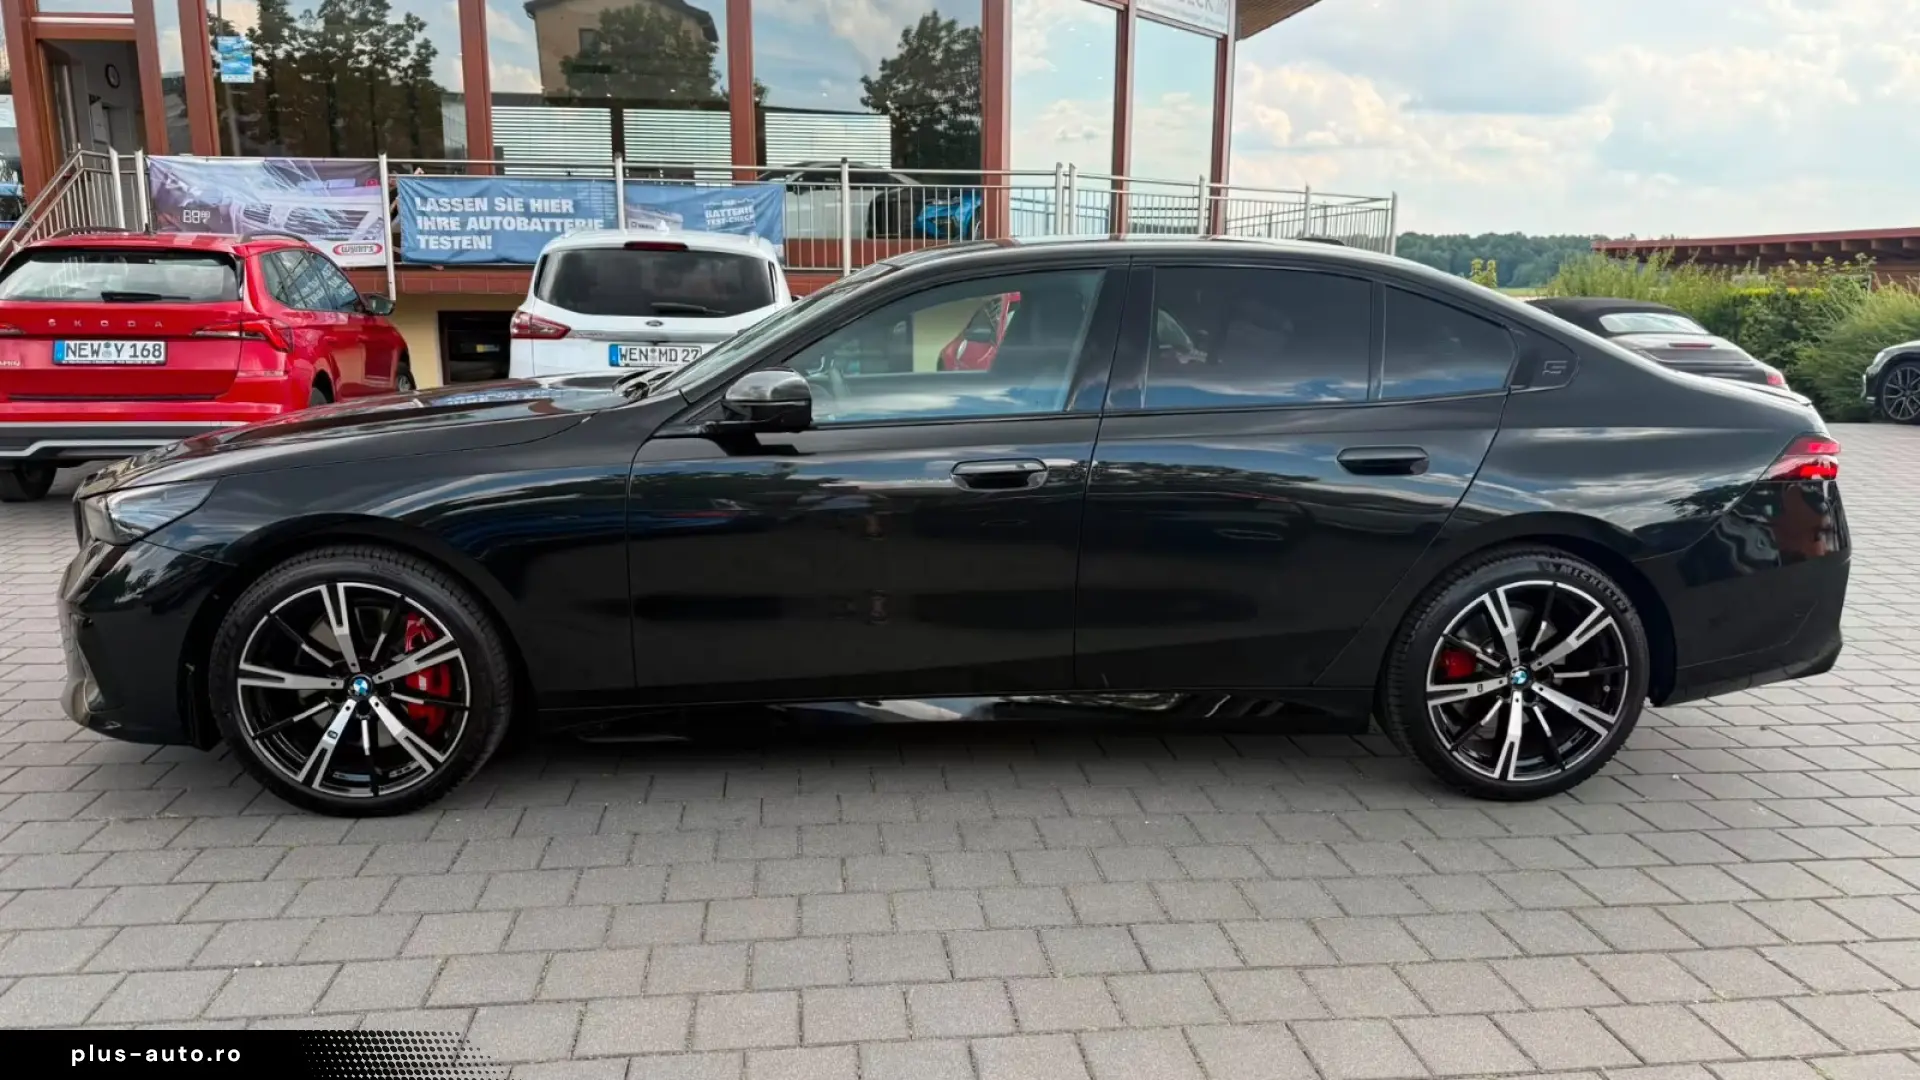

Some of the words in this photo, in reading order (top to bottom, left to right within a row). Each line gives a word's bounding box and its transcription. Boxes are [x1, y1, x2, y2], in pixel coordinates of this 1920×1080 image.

[415, 197, 488, 213] LASSEN
[494, 197, 525, 212] SIE
[530, 198, 574, 213] HIER
[417, 216, 460, 230] IHRE
[466, 216, 604, 232] AUTOBATTERIE
[417, 235, 493, 249] TESTEN!
[65, 342, 101, 358] NEW
[114, 343, 125, 358] Y
[129, 343, 162, 358] 168
[619, 347, 648, 362] WEN
[658, 348, 678, 362] MD
[681, 349, 699, 362] 27
